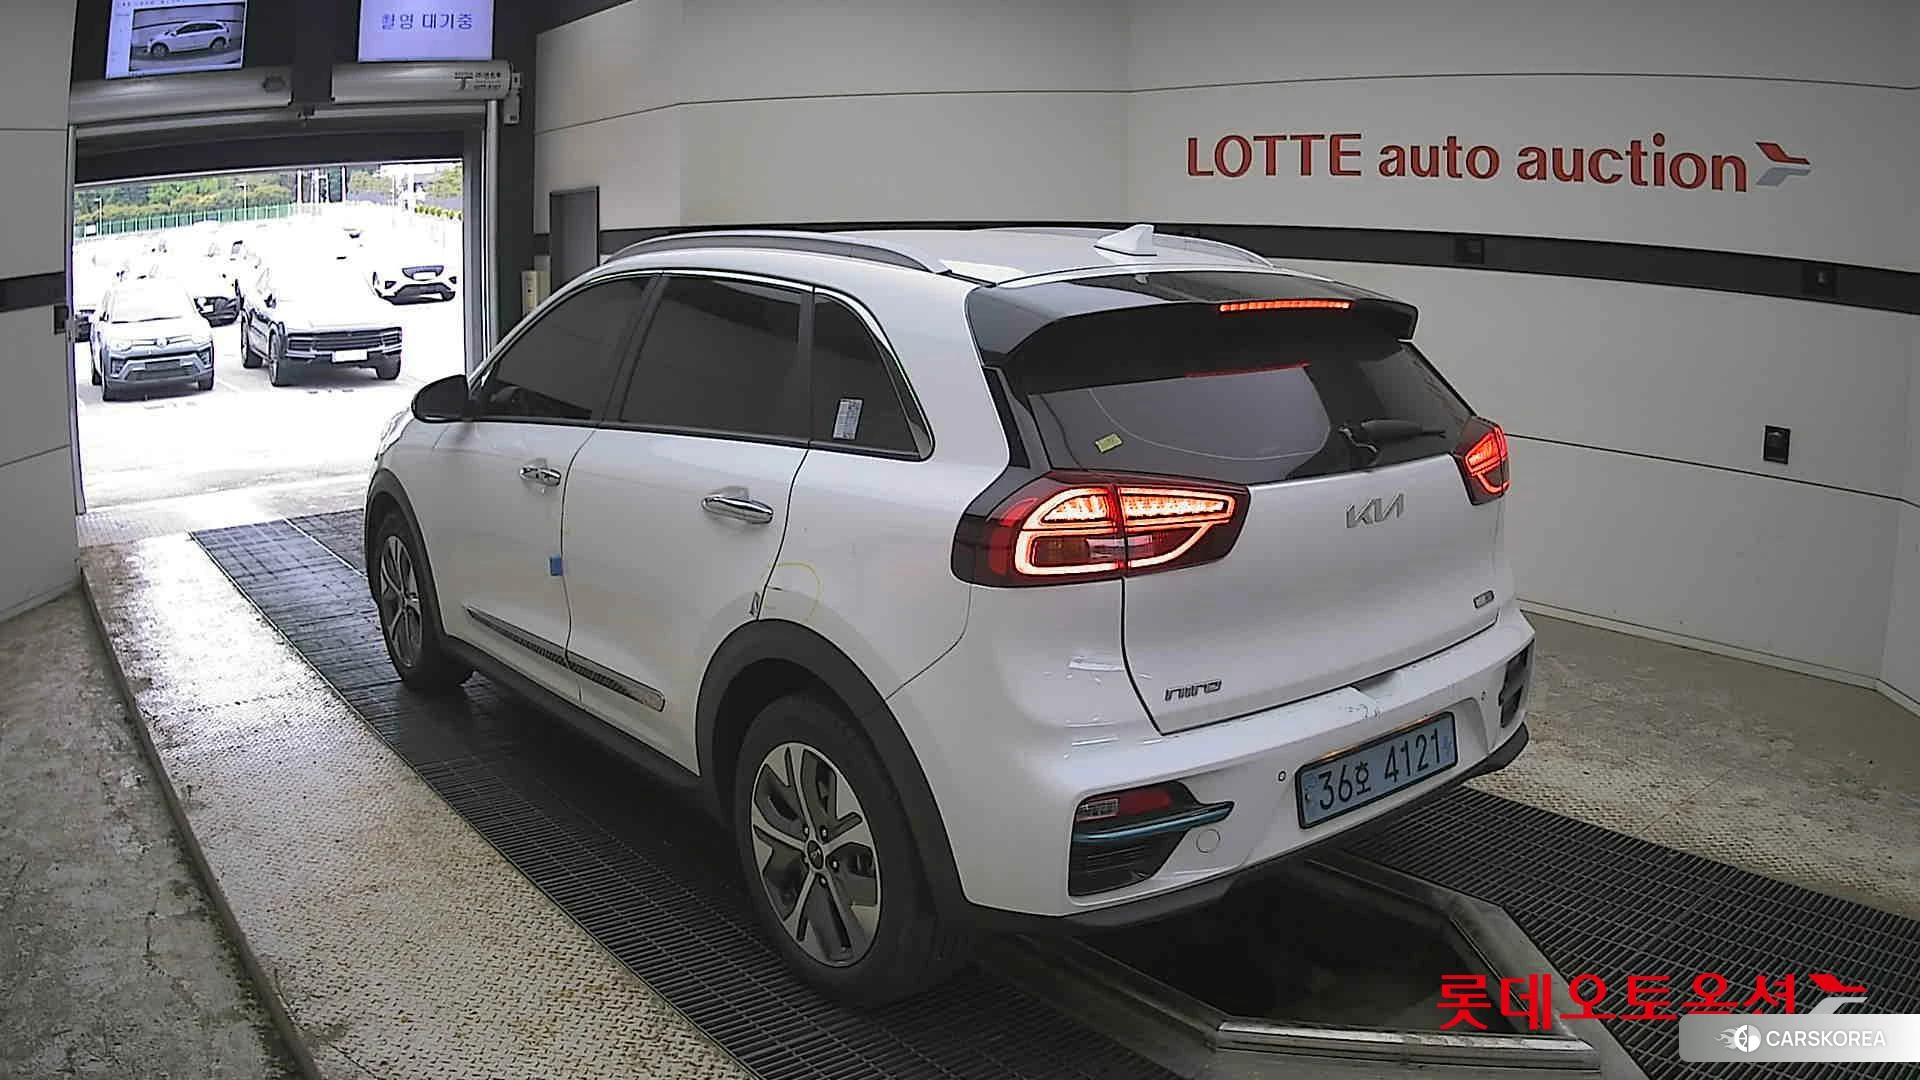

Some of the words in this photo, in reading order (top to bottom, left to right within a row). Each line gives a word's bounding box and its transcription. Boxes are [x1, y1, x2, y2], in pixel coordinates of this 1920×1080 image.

[422, 13, 473, 30] 대기중
[1187, 133, 1362, 177] LOTTE
[1379, 136, 1500, 180] auto
[1516, 132, 1748, 192] auction
[1345, 493, 1406, 528] KIA
[1317, 761, 1371, 810] 36호
[1384, 728, 1440, 783] 4121
